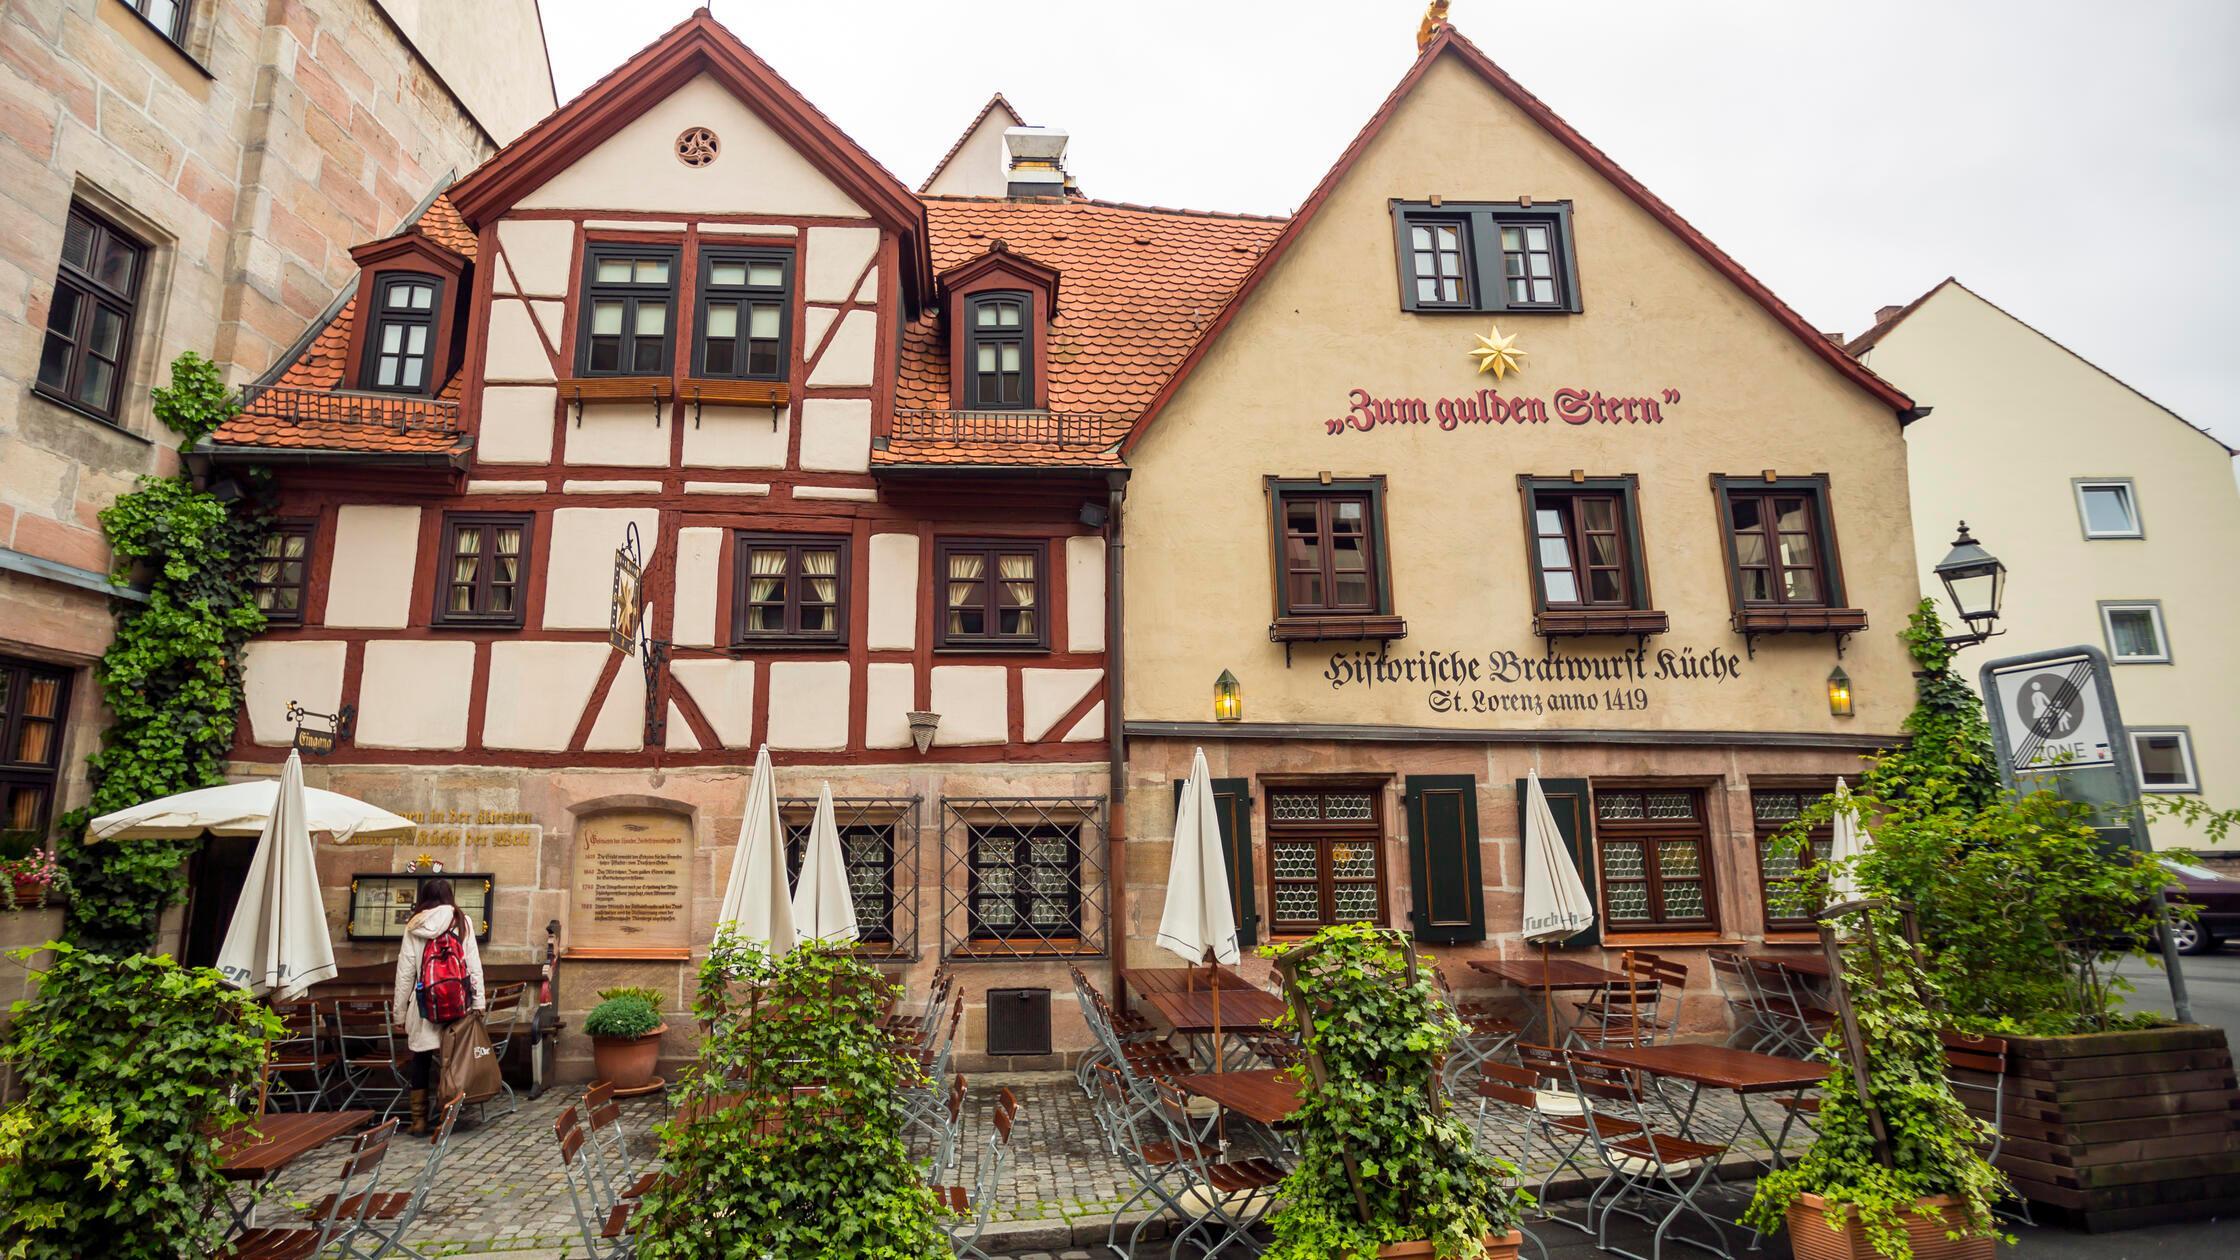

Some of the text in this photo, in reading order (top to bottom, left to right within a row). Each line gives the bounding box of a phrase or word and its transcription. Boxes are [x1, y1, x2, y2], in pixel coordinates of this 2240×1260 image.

[1435, 388, 1549, 432] gulden
[1654, 646, 1741, 684] Küche
[1428, 687, 1648, 716] St. Lorenz anno 1419
[299, 730, 333, 751] Eingang
